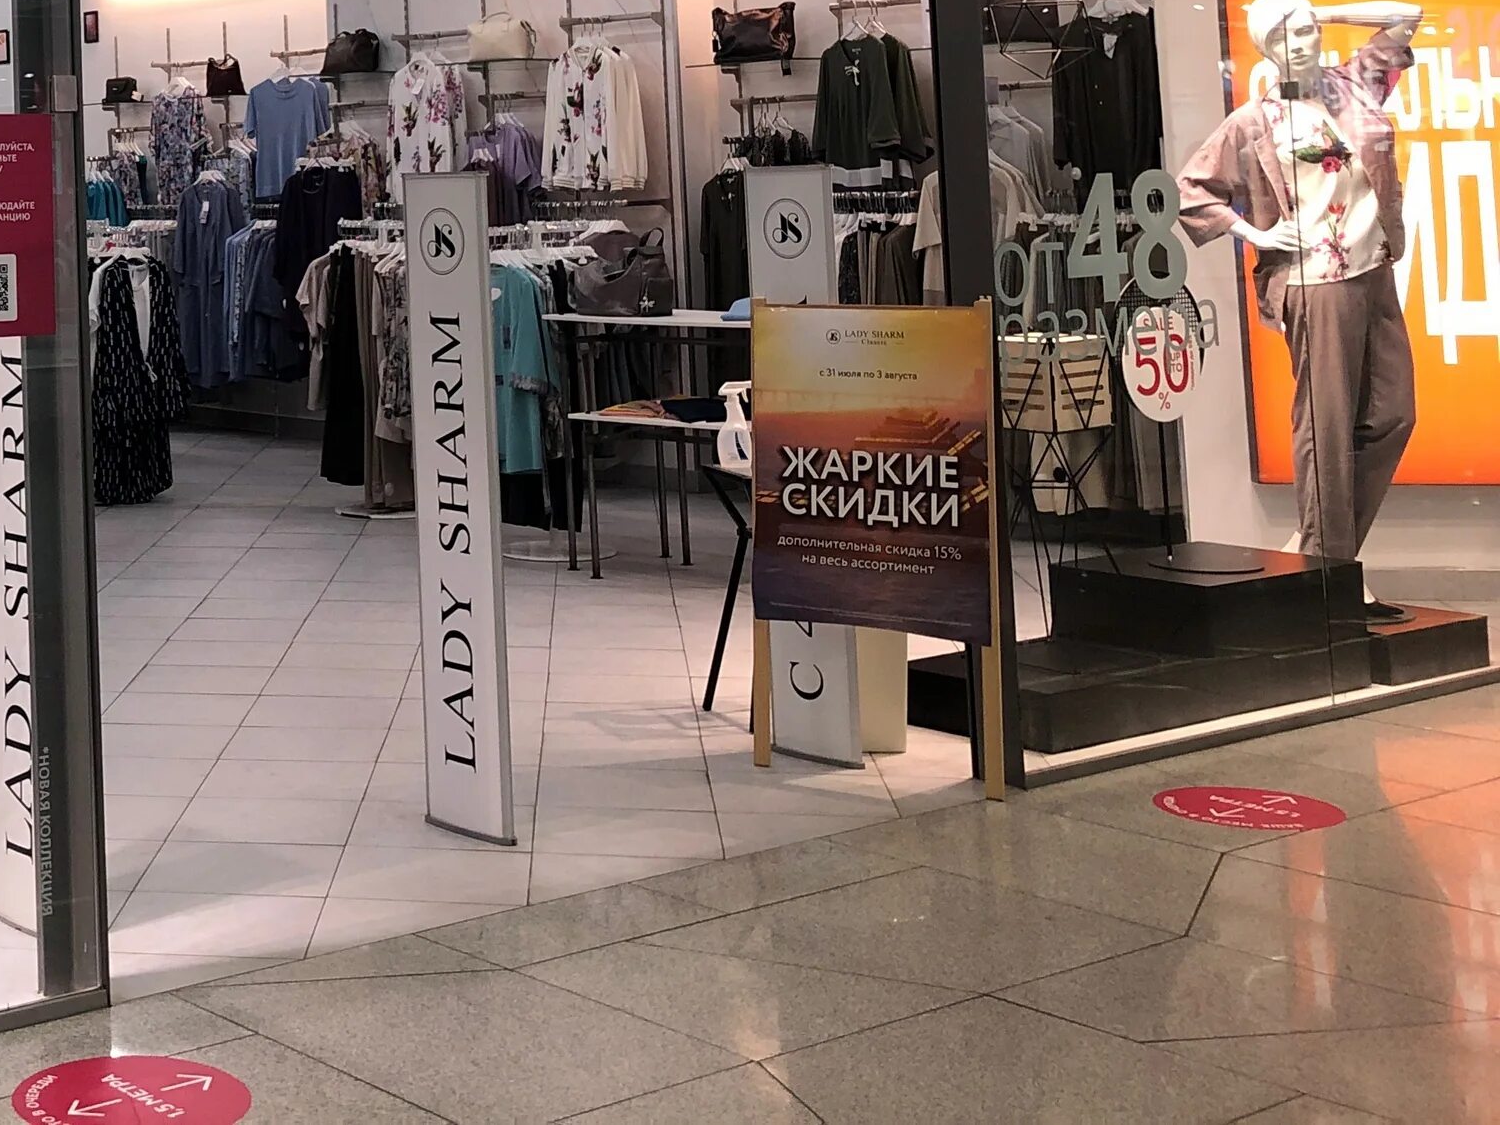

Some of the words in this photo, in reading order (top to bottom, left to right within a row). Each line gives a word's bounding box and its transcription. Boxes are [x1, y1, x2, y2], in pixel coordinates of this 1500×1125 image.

[994, 241, 1065, 307] от
[1067, 168, 1189, 305] 48
[844, 330, 869, 339] LADY
[871, 330, 905, 339] SHARM
[998, 298, 1221, 387] размера
[826, 367, 836, 377] 31
[837, 370, 862, 378] июля
[876, 370, 883, 378] 3
[884, 372, 918, 381] августа
[1135, 333, 1189, 397] 50
[428, 311, 472, 556] SHARM
[0, 349, 29, 621] SHARM
[781, 445, 960, 489] ЖАРКИЕ
[781, 482, 960, 528] СКИДКИ
[777, 535, 882, 554] дополнительная
[885, 544, 931, 560] скидка
[934, 546, 963, 561] 15%
[801, 554, 817, 565] на
[819, 556, 849, 568] весь
[850, 558, 936, 575] ассортимент
[440, 577, 477, 775] LADY
[4, 645, 34, 865] LADY
[40, 809, 54, 917] КОЛЛЕКЦИЯ
[25, 1074, 58, 1109] ОЧЕРЕДИ
[101, 1073, 156, 1107] МЕТРА
